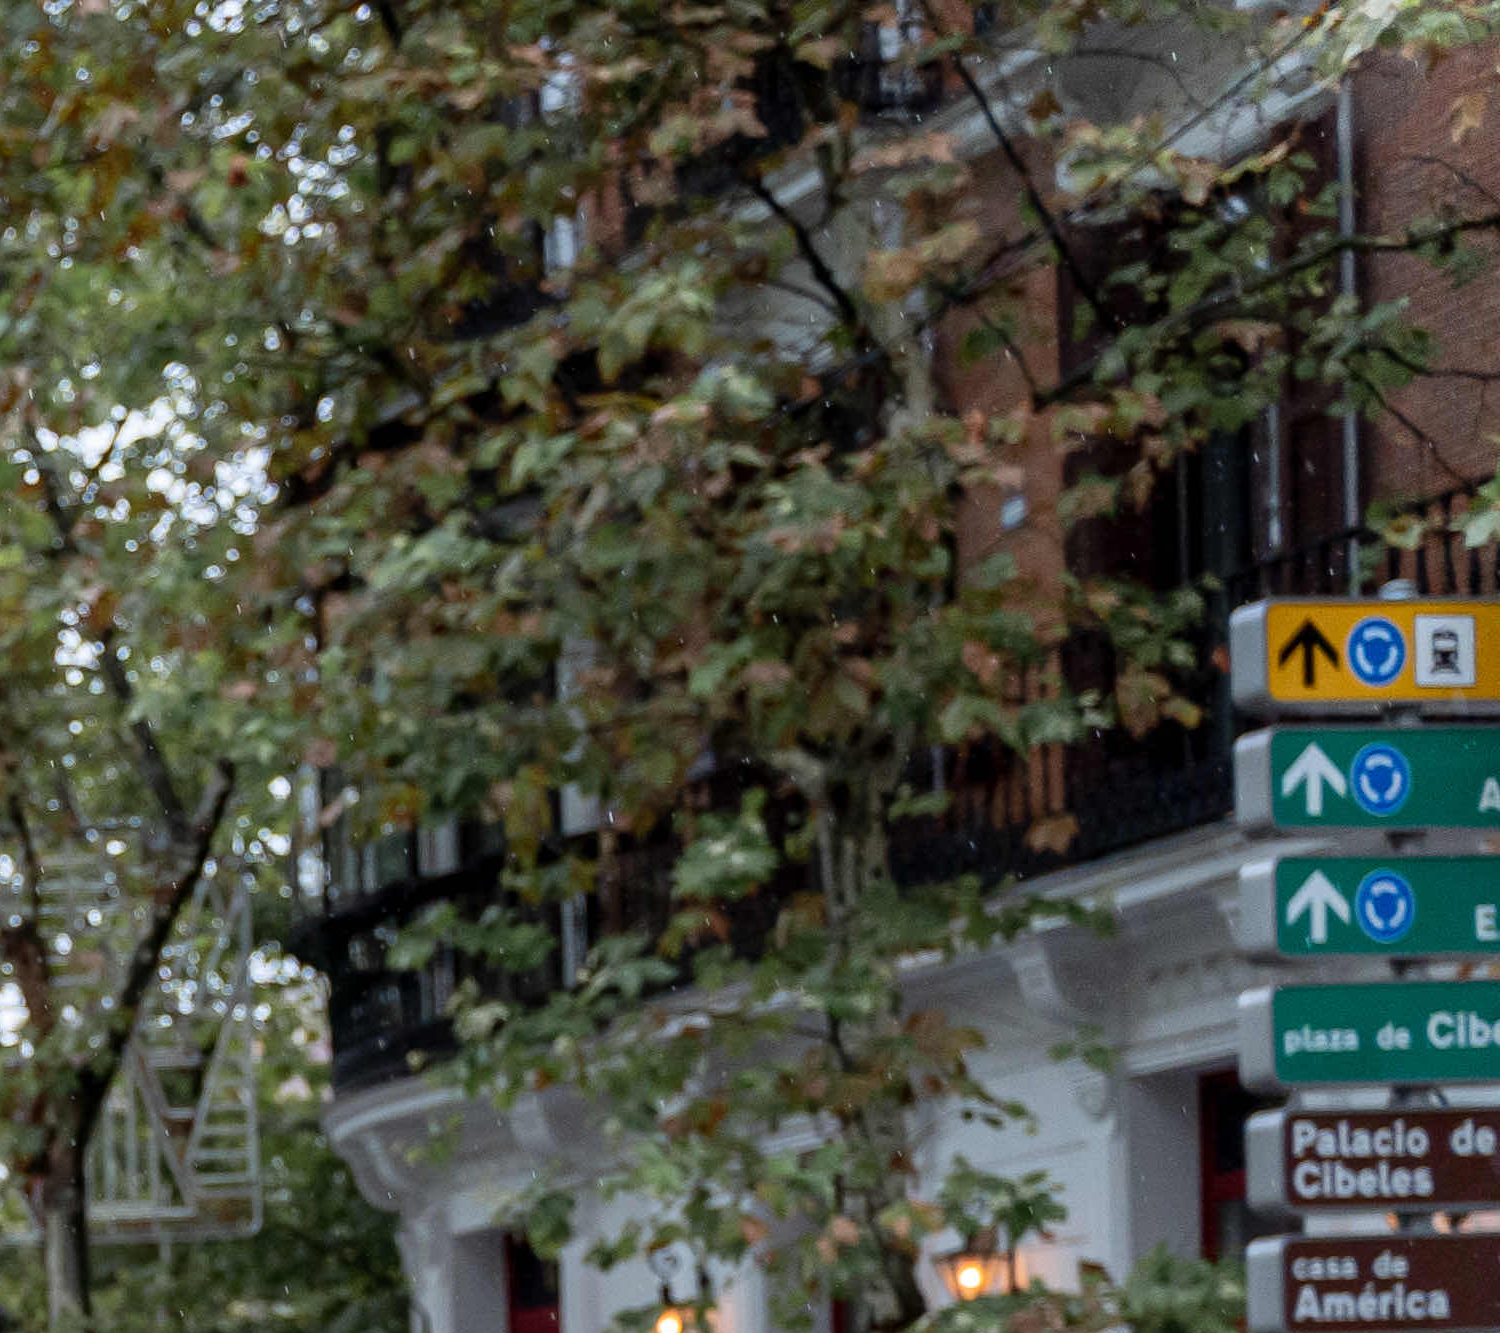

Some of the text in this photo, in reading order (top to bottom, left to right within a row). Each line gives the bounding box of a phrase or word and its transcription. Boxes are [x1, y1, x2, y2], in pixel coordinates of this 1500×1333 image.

[1283, 1023, 1359, 1056] plaza
[1376, 1021, 1411, 1050] de
[1291, 1118, 1497, 1158] Palacio de
[1293, 1160, 1434, 1198] Cibeles
[1292, 1250, 1409, 1281] casa de
[1293, 1282, 1450, 1322] América
